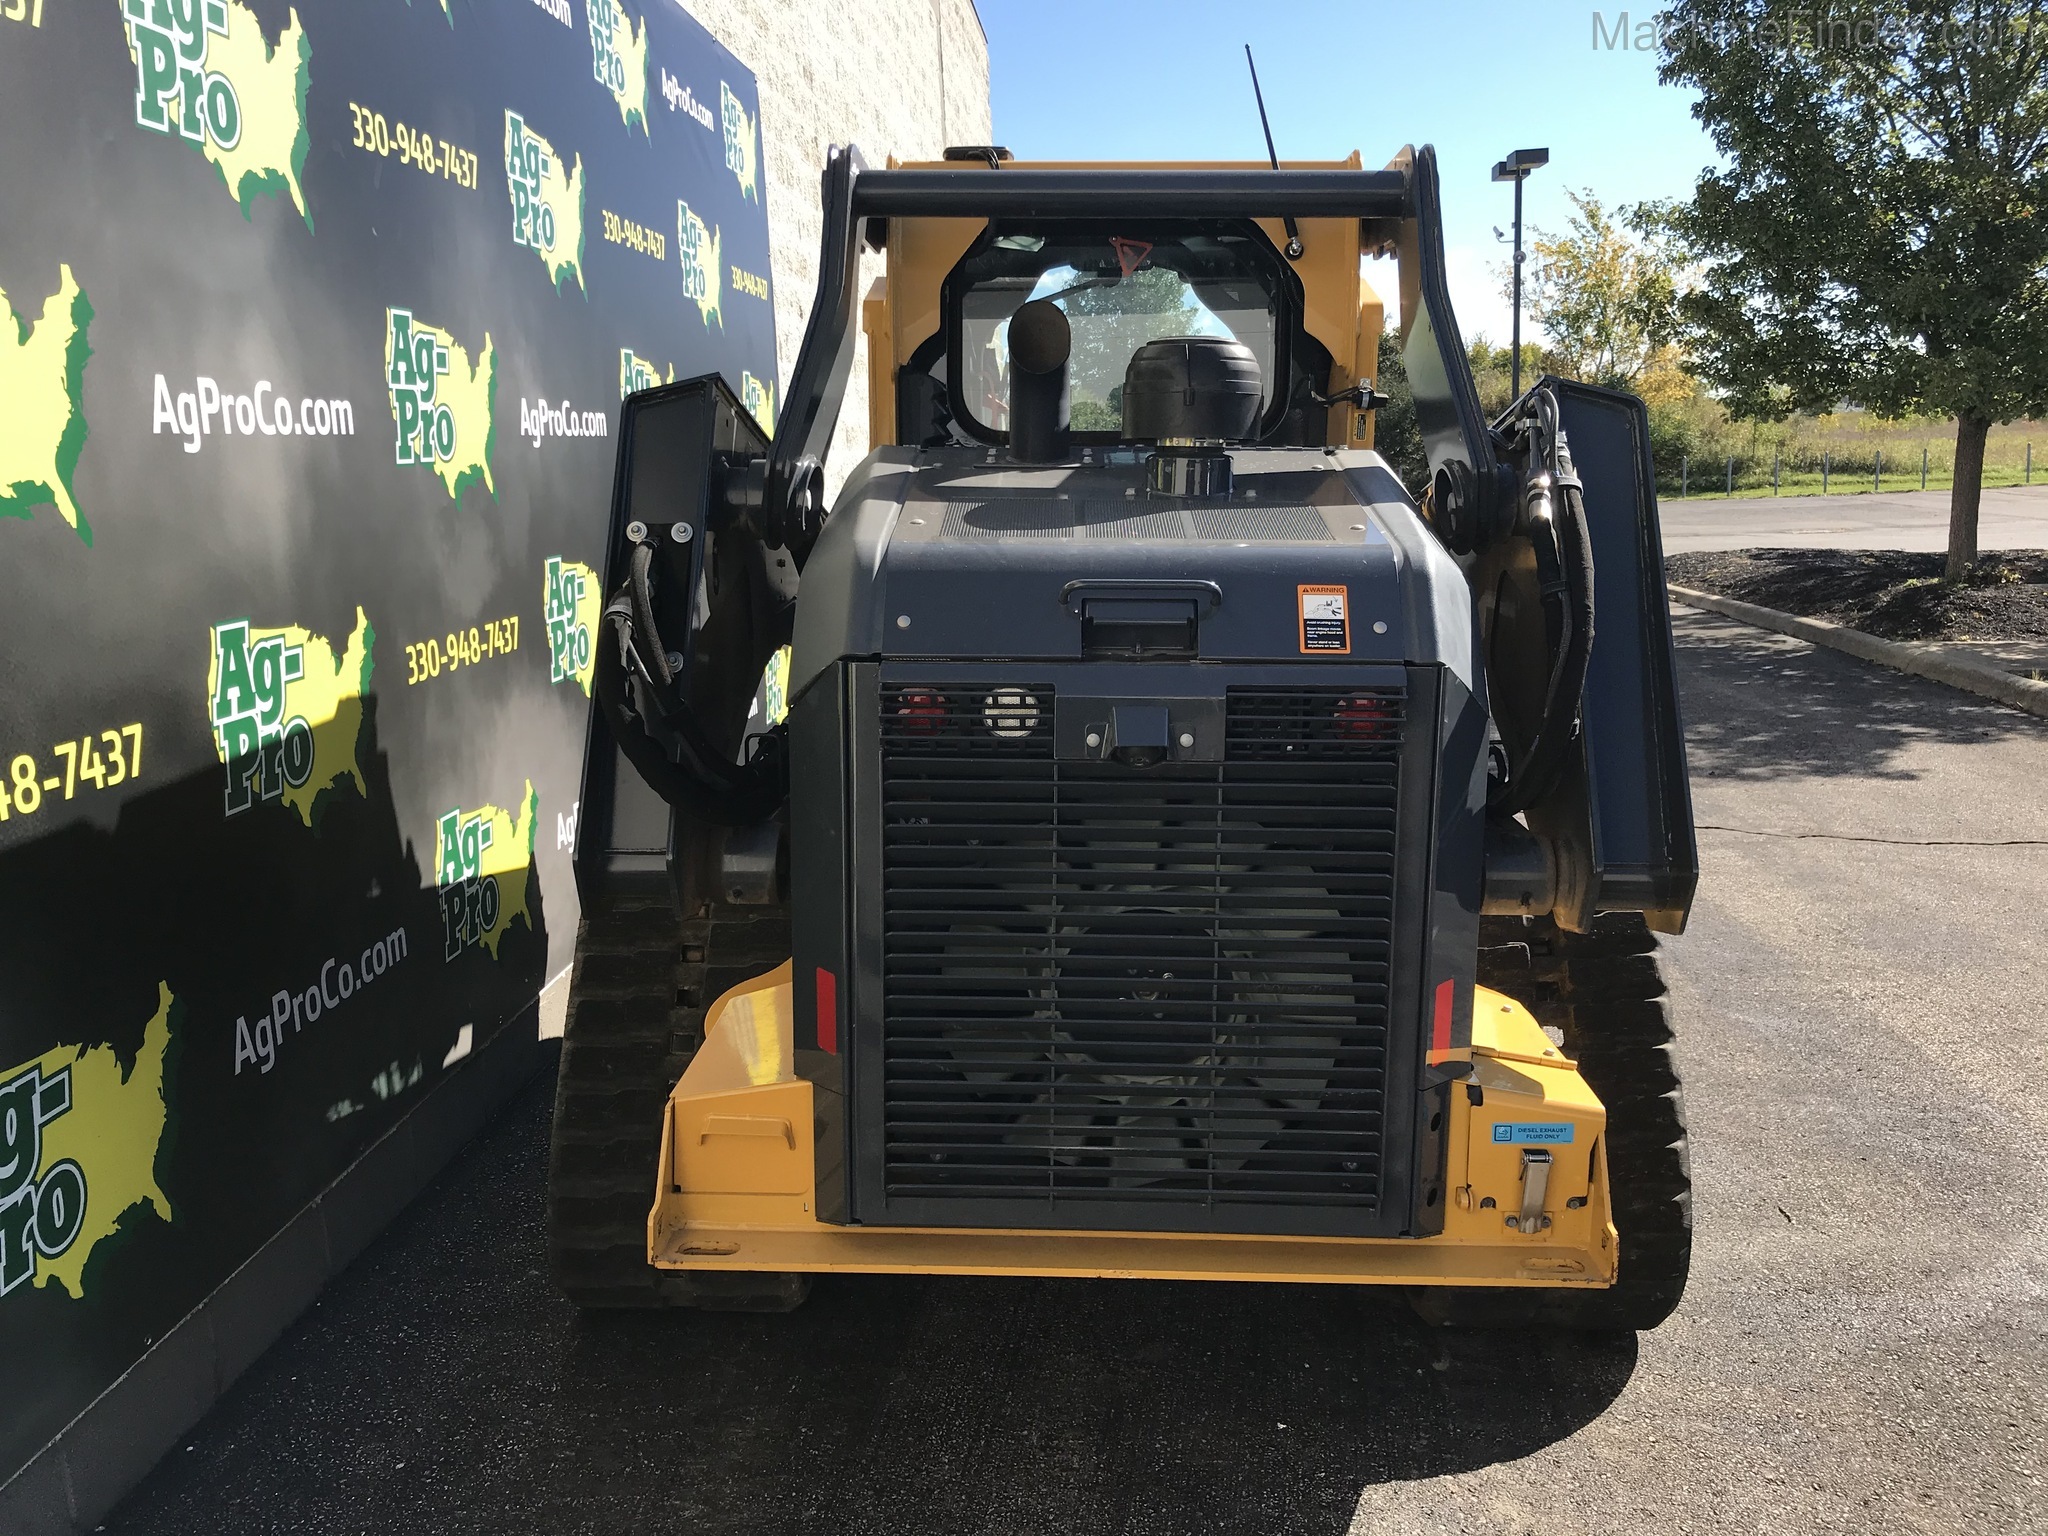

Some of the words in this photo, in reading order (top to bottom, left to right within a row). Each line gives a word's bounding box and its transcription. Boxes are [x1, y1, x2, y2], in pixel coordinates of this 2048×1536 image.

[135, 22, 241, 150] Pro
[592, 23, 626, 97] Pro
[661, 67, 714, 132] AgProCo.com
[349, 102, 478, 190] 330-948-7437
[724, 128, 745, 176] Pro
[511, 178, 556, 251] Pro
[602, 209, 665, 261] 330-948-7437
[682, 249, 706, 301] Pro
[153, 373, 355, 454] AgProCo.com
[393, 387, 457, 465] Pro
[520, 398, 608, 448] AgProCo.com
[405, 616, 520, 686] 330-948-7437
[550, 619, 591, 683] Pro
[219, 715, 314, 818] Pro
[443, 874, 499, 963] Pro
[234, 926, 409, 1076] AgProCo.com
